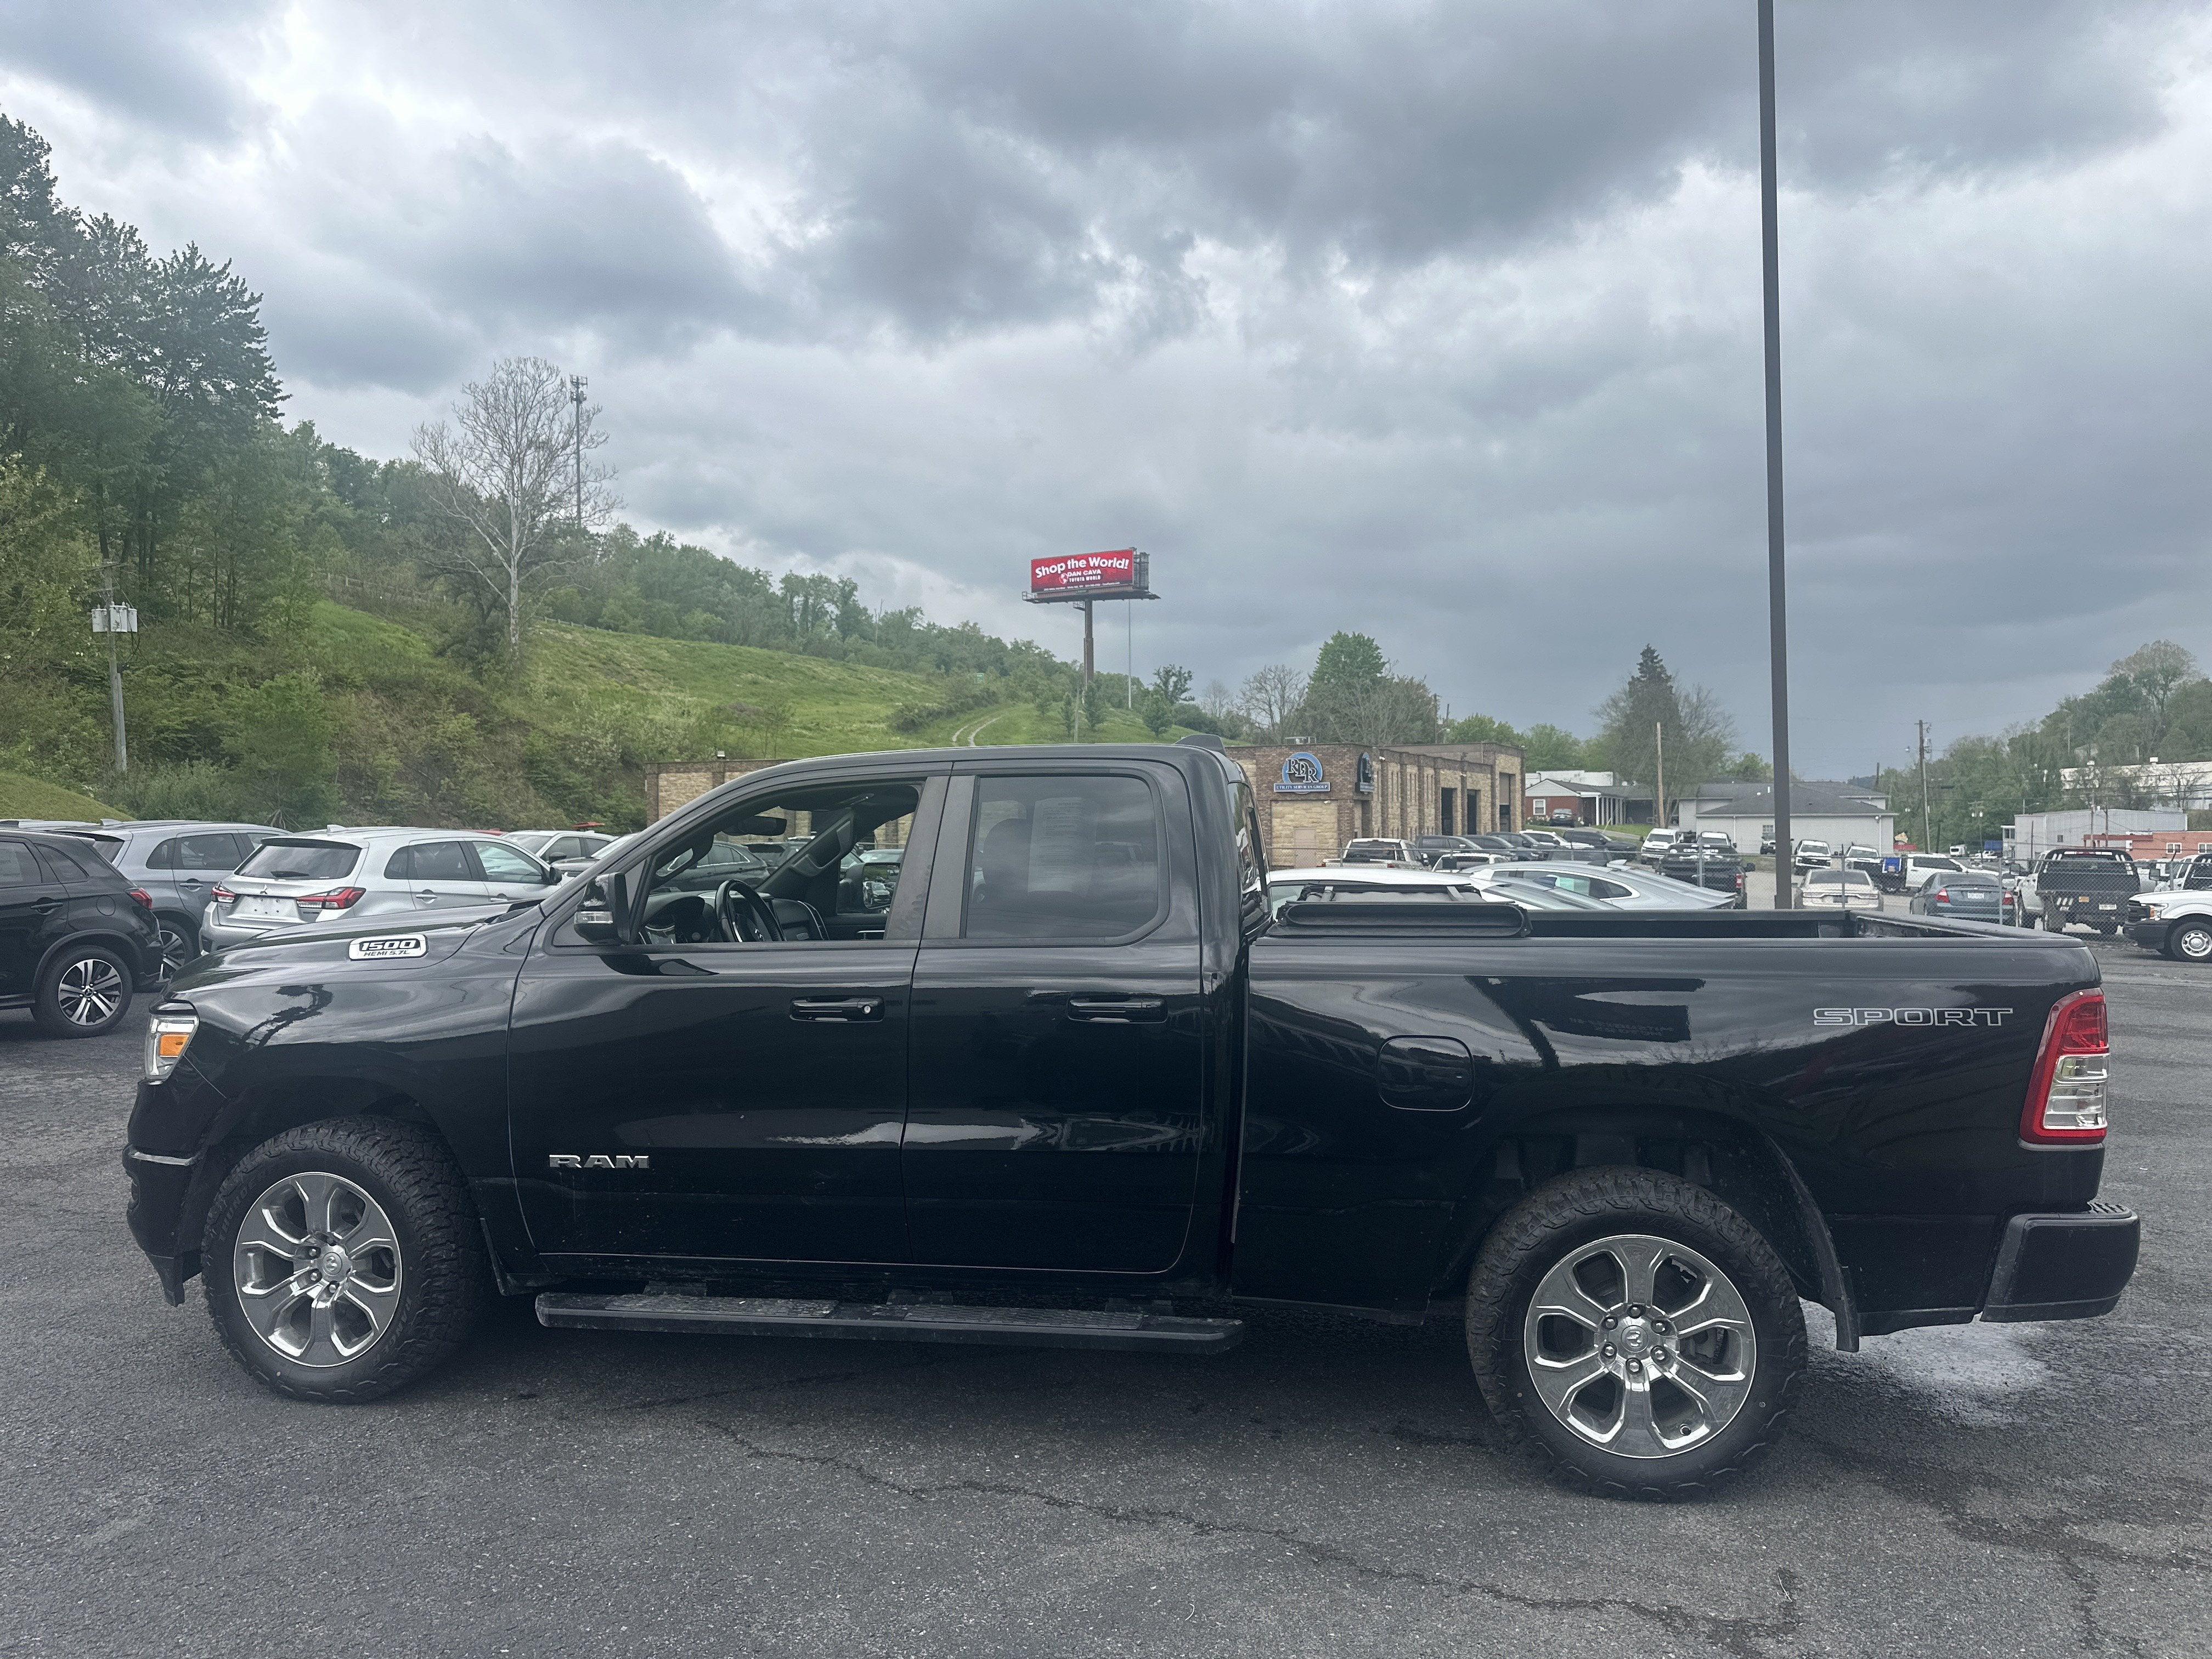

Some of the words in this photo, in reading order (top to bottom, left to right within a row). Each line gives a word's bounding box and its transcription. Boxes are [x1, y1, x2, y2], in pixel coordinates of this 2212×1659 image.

[1035, 562, 1066, 578] Shop
[1067, 558, 1087, 570] the
[1087, 557, 1130, 570] World!
[1286, 758, 1319, 783] RDR
[361, 940, 416, 951] 1500
[1813, 1008, 2013, 1026] SPORT
[549, 1154, 650, 1169] RAM
